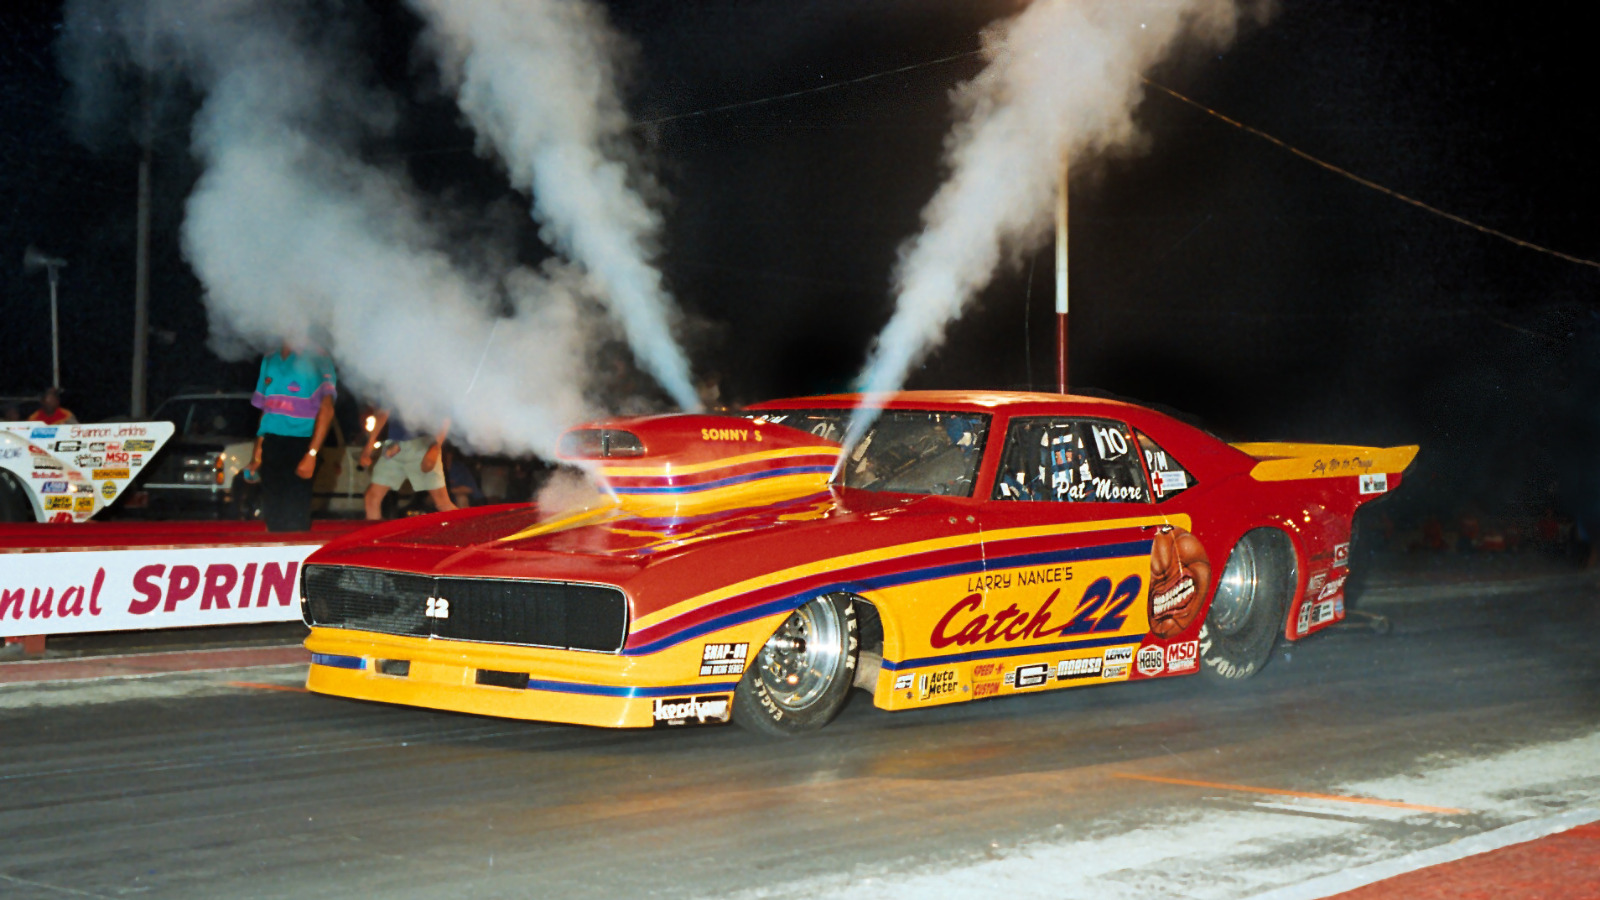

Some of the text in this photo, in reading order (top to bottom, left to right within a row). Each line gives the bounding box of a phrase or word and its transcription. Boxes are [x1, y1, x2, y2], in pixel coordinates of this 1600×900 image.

[701, 428, 748, 442] SONNY
[105, 452, 129, 462] MSD
[1144, 449, 1168, 471] P/M
[1056, 479, 1085, 498] Pat
[1092, 477, 1142, 501] Moore
[127, 562, 299, 615] SPRIN
[968, 566, 1073, 593] LARRY NANCE'S
[930, 573, 1142, 649] Catch 22
[1106, 648, 1132, 661] LENCO
[1168, 642, 1196, 662] MSD
[930, 670, 954, 683] Auto
[1057, 657, 1103, 679] MOROSO
[928, 681, 959, 695] Meter
[974, 682, 1000, 697] CUSTOM
